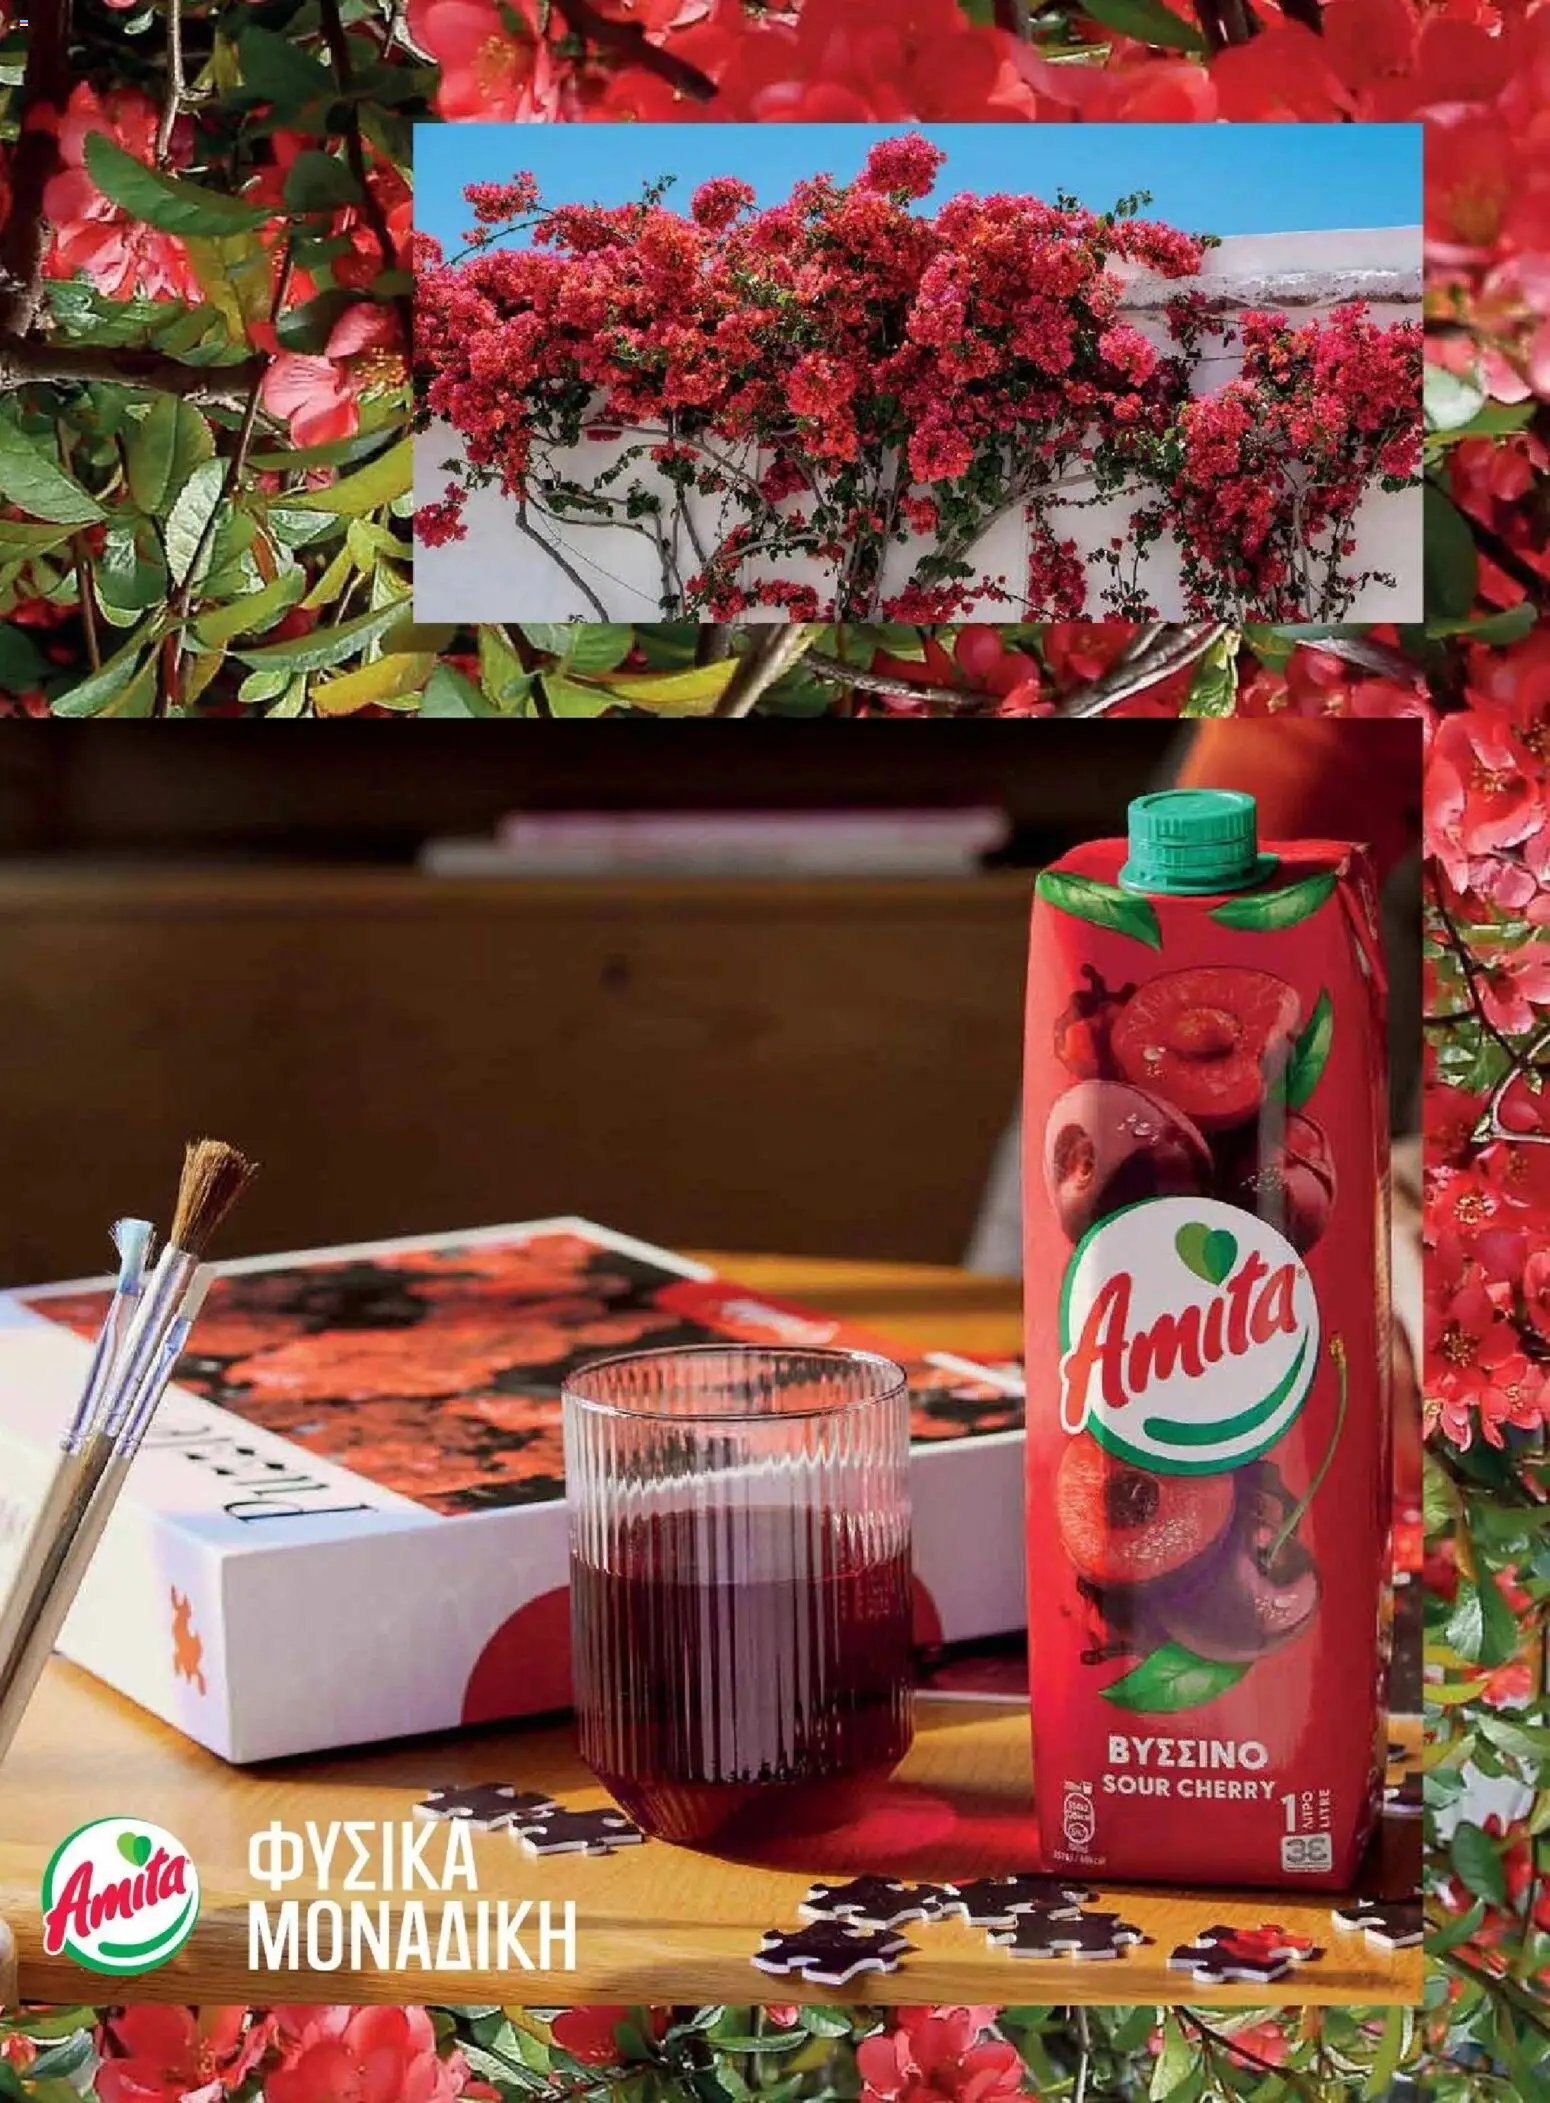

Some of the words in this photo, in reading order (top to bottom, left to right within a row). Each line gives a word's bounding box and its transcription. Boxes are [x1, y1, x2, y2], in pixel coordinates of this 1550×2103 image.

[1063, 1250, 1298, 1430] Amita
[1108, 1734, 1269, 1771] ΒΥΣΣΙΝΟ
[1102, 1773, 1171, 1798] SOUR
[1177, 1778, 1276, 1800] CHERRY
[1280, 1793, 1296, 1832] 1
[1318, 1788, 1331, 1829] LITRE
